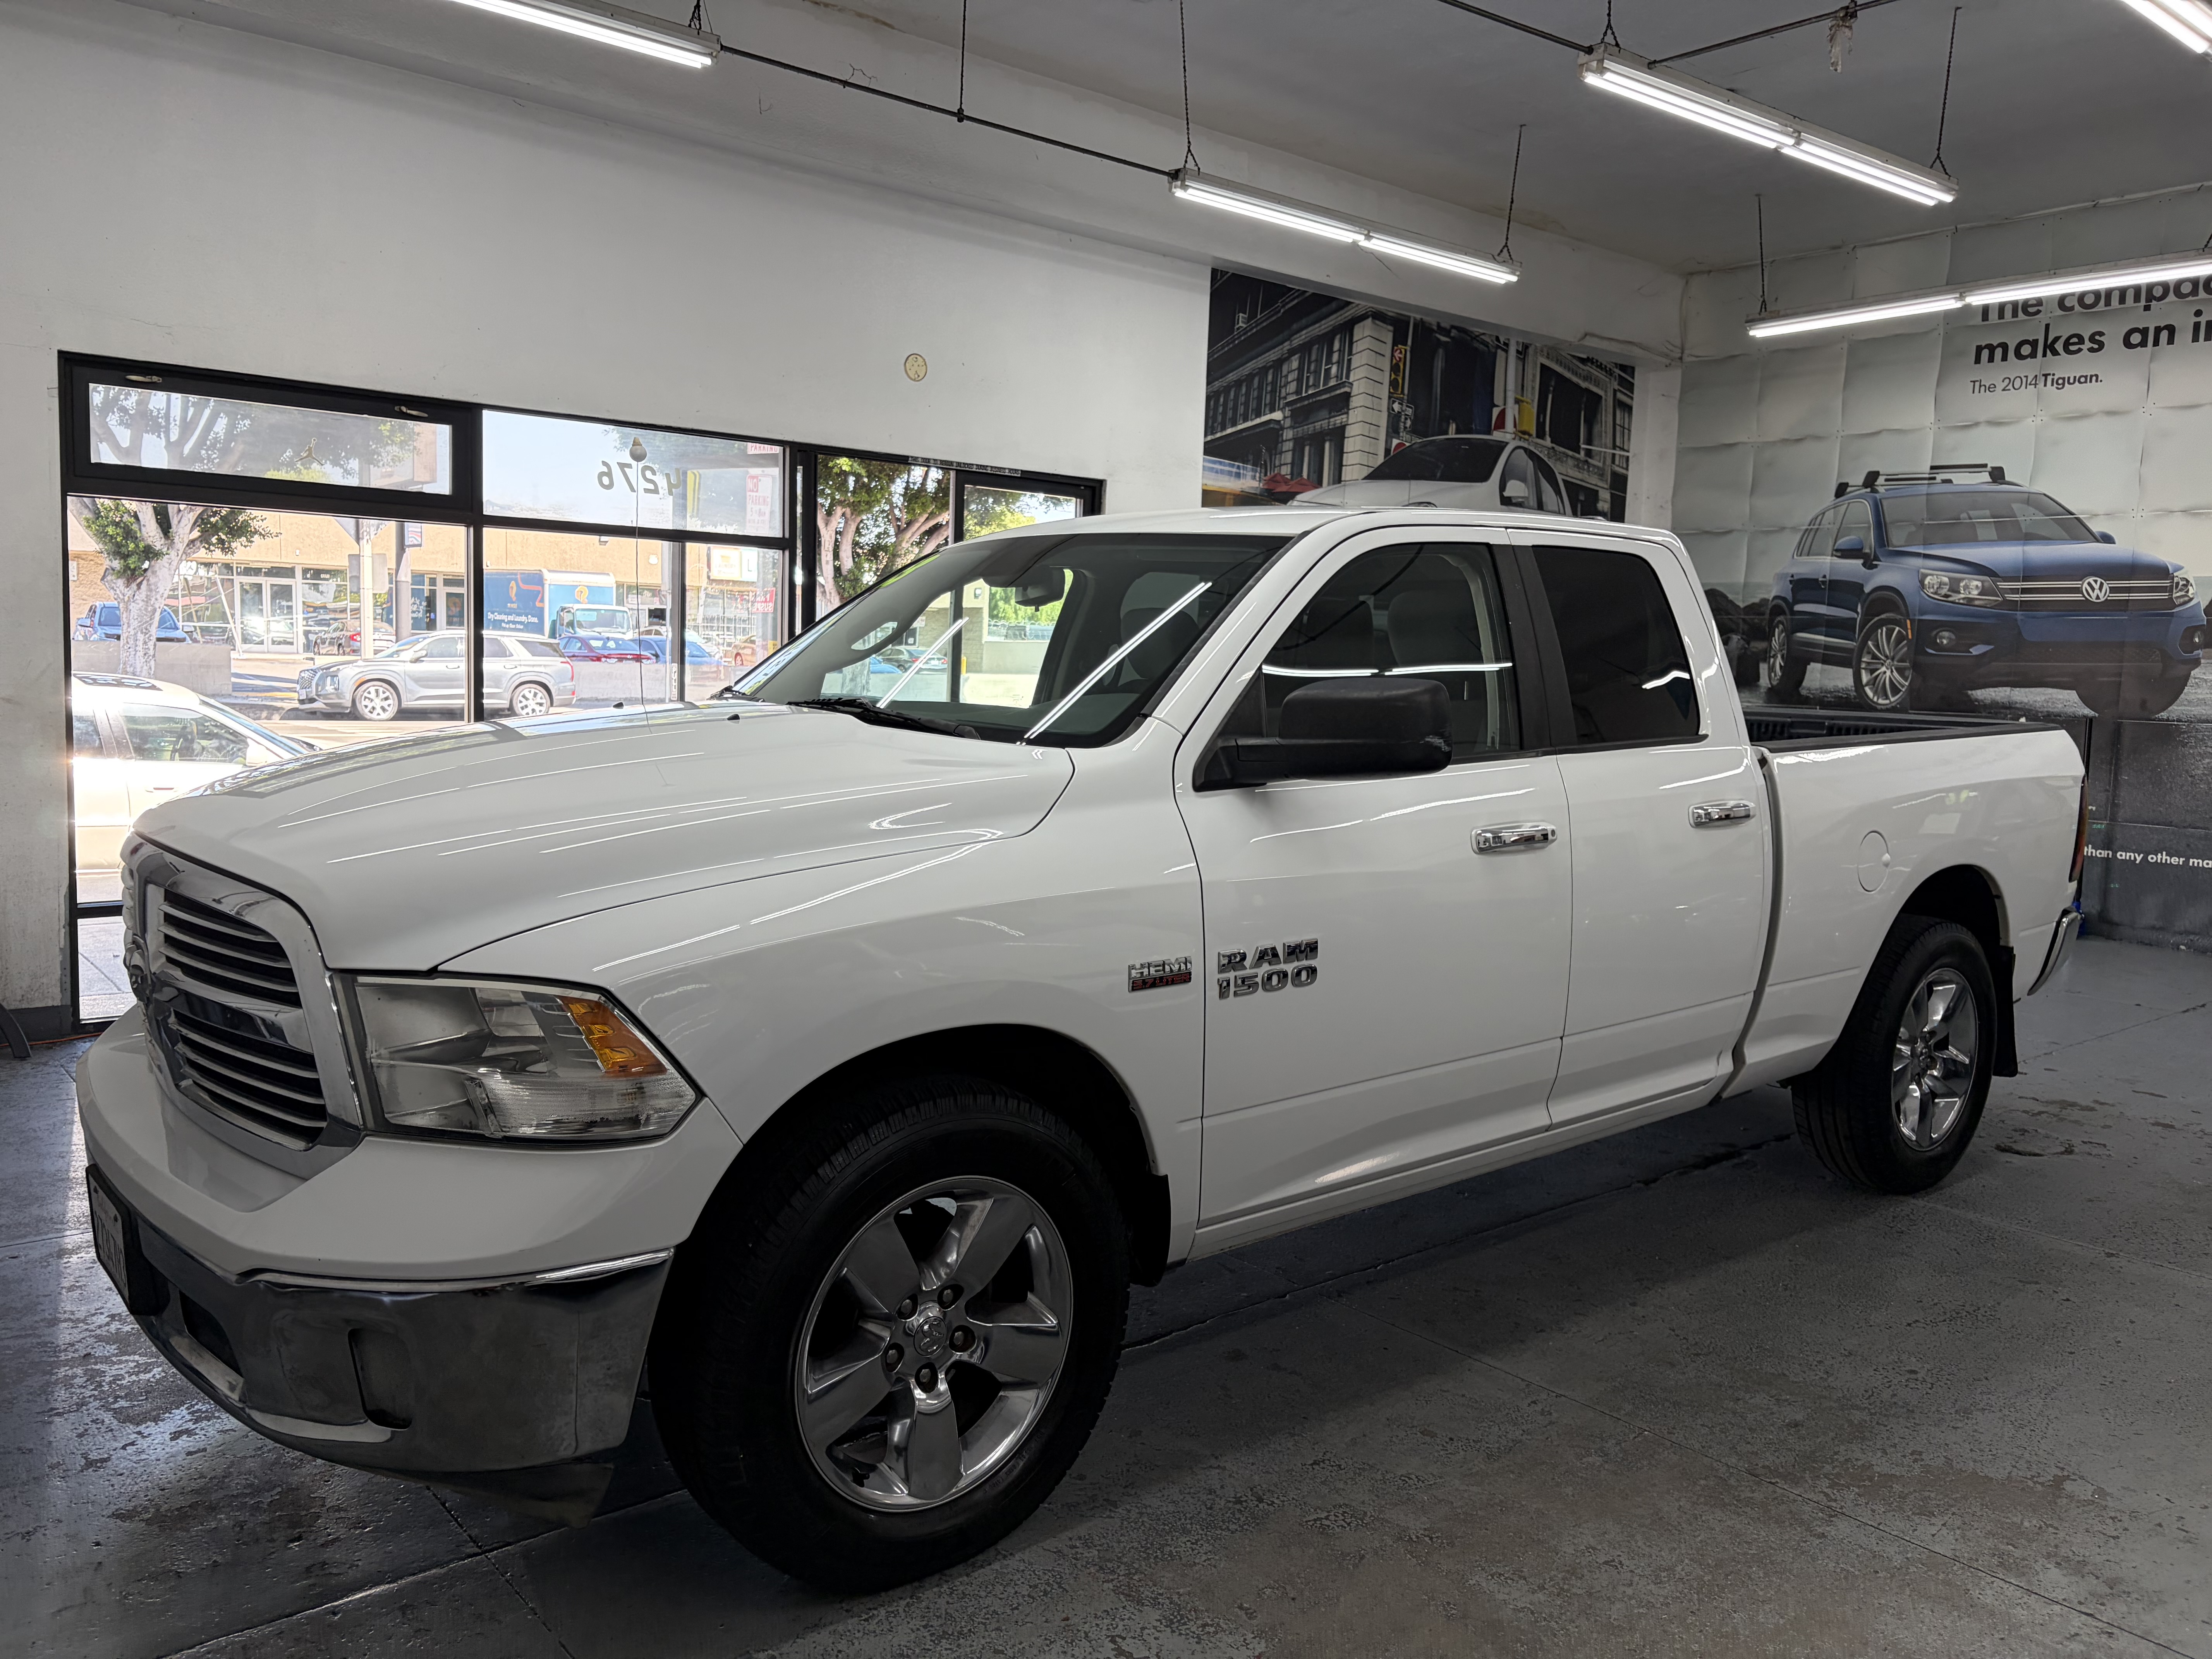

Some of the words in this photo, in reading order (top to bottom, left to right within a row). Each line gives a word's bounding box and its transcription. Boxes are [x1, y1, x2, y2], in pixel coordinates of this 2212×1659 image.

[1974, 323, 2105, 365] makes
[2123, 323, 2176, 350] an
[1970, 380, 1996, 394] The
[2001, 374, 2039, 392] 2014
[2042, 372, 2103, 390] Tiguan.
[748, 478, 758, 491] NO
[748, 495, 769, 506] PARKING
[2084, 845, 2112, 858] than
[2117, 851, 2143, 863] any
[2148, 851, 2185, 866] other
[1218, 938, 1318, 974] RAM
[1128, 956, 1192, 979] HEMI
[1133, 979, 1154, 990] 5.7
[1156, 973, 1190, 987] LITER
[1218, 964, 1317, 1000] 1500
